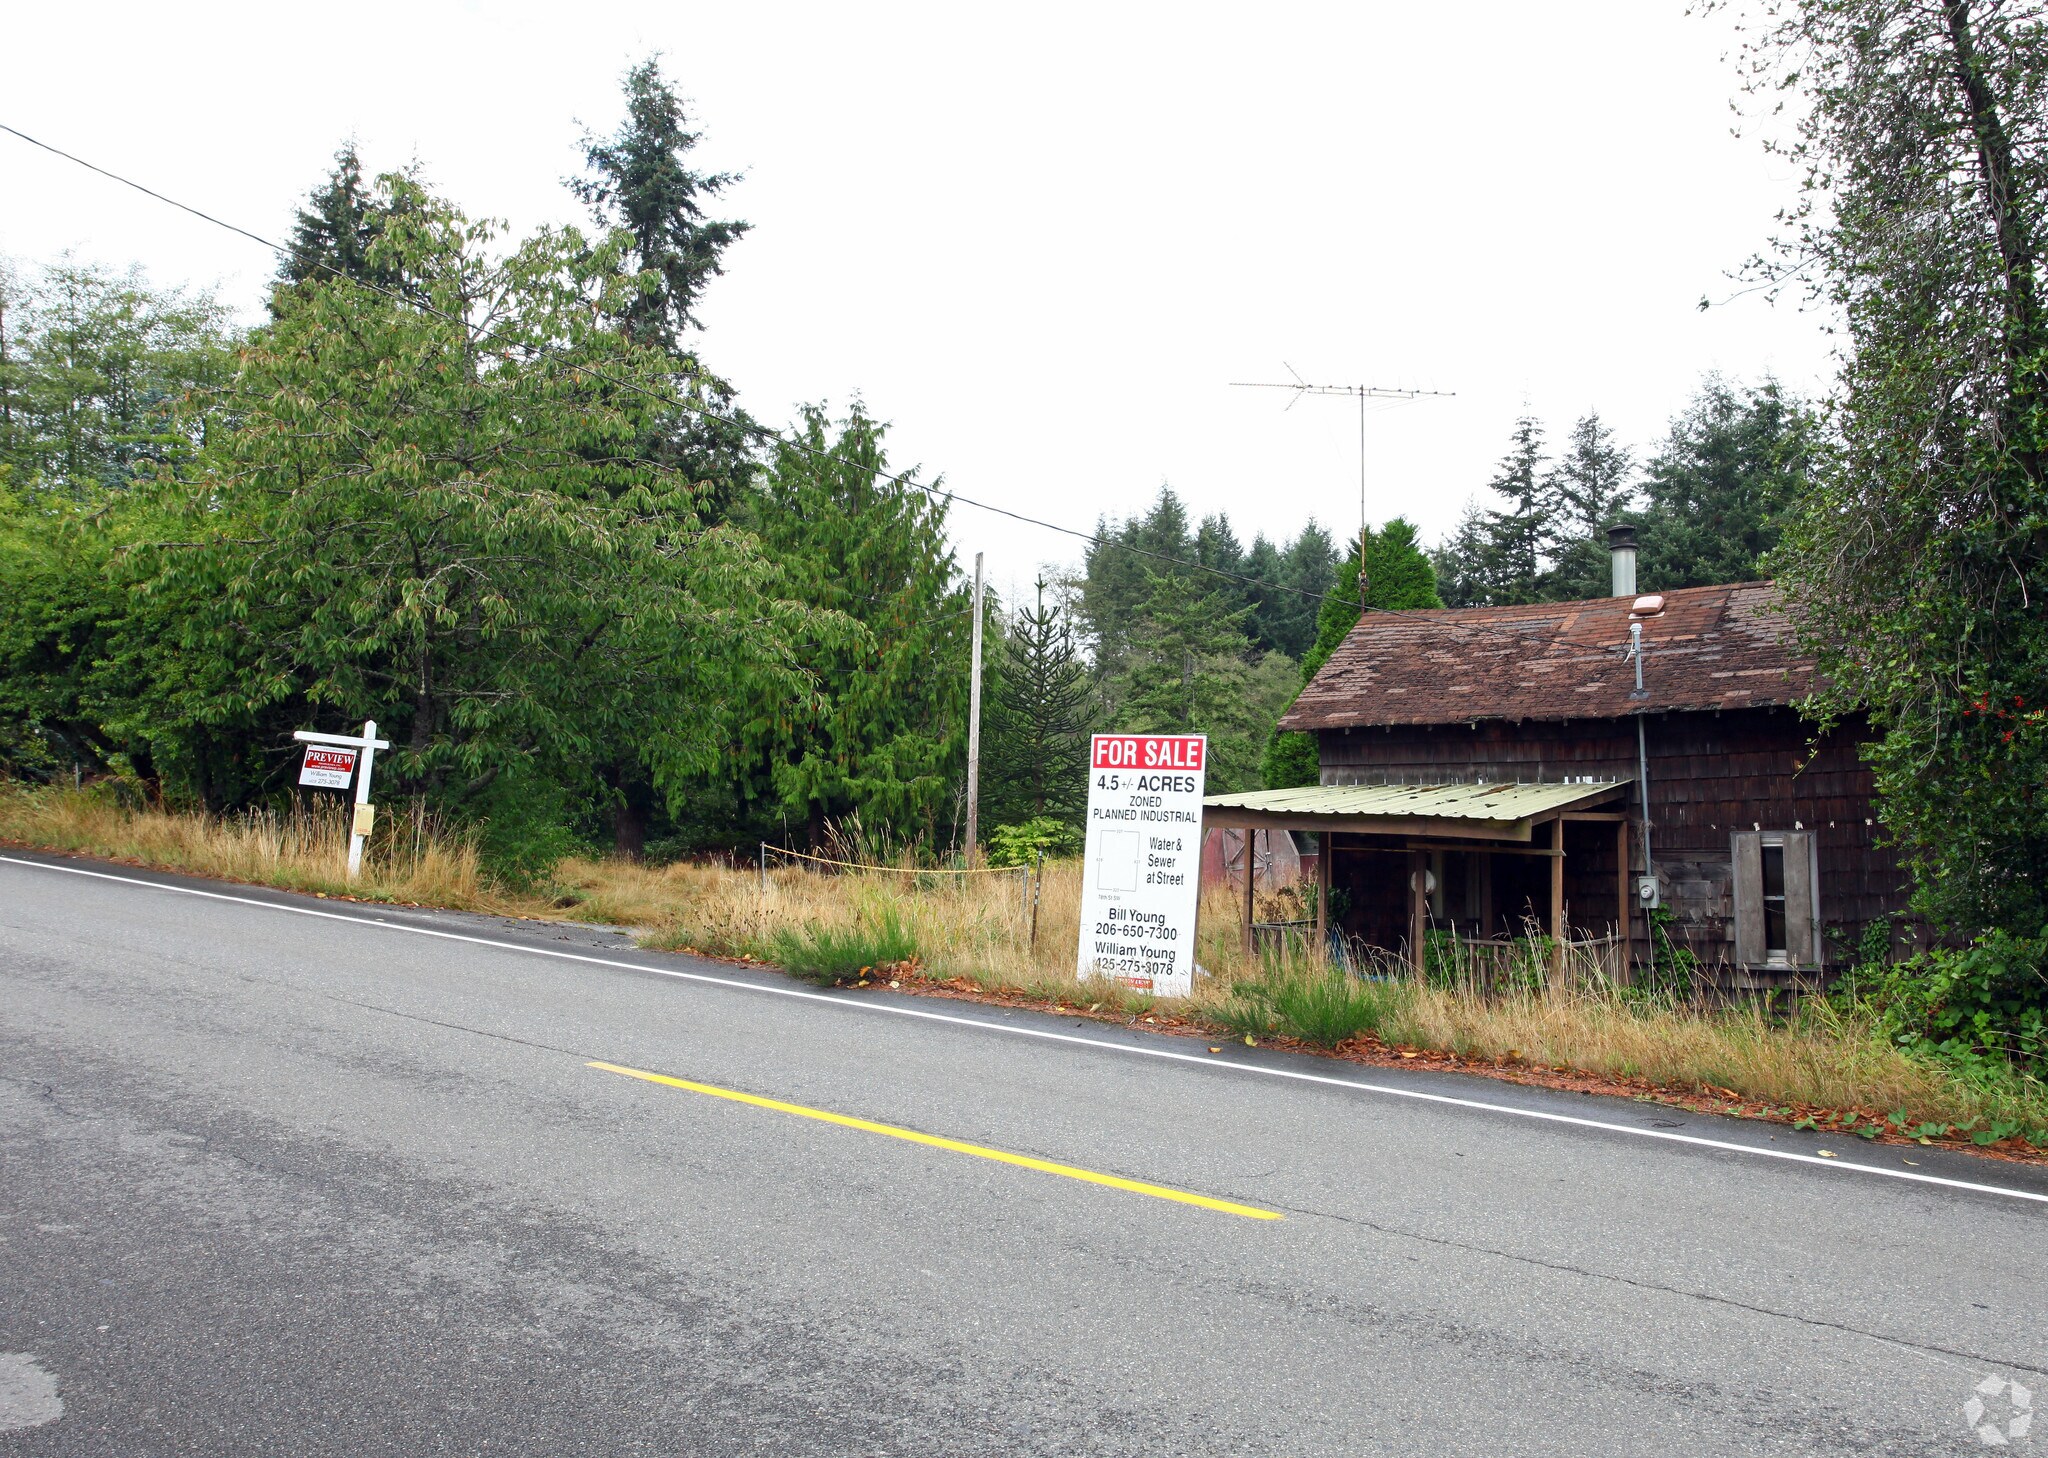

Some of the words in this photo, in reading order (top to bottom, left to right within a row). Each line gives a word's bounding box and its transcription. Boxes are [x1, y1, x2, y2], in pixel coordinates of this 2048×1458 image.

[307, 751, 354, 764] PREVIEW
[1096, 740, 1137, 765] FOR
[1144, 740, 1199, 766] SALE
[328, 772, 342, 780] Young
[1097, 775, 1119, 790] 4.5
[1137, 775, 1195, 793] ACRES
[1129, 795, 1162, 808] ZONED
[1093, 808, 1137, 821] PLANNED
[1140, 810, 1197, 823] INDUSTRIAL
[1149, 836, 1175, 851] Water
[1175, 838, 1183, 851] &
[1147, 853, 1176, 868] Sewer
[1146, 872, 1155, 884] at
[1156, 871, 1184, 886] Street
[1108, 908, 1127, 920] Bill
[1129, 909, 1165, 927] Young
[1095, 922, 1178, 940] 206-650-7300
[1095, 941, 1137, 956] William
[1139, 945, 1176, 963] Young
[1095, 957, 1173, 975] 425-275-3078
